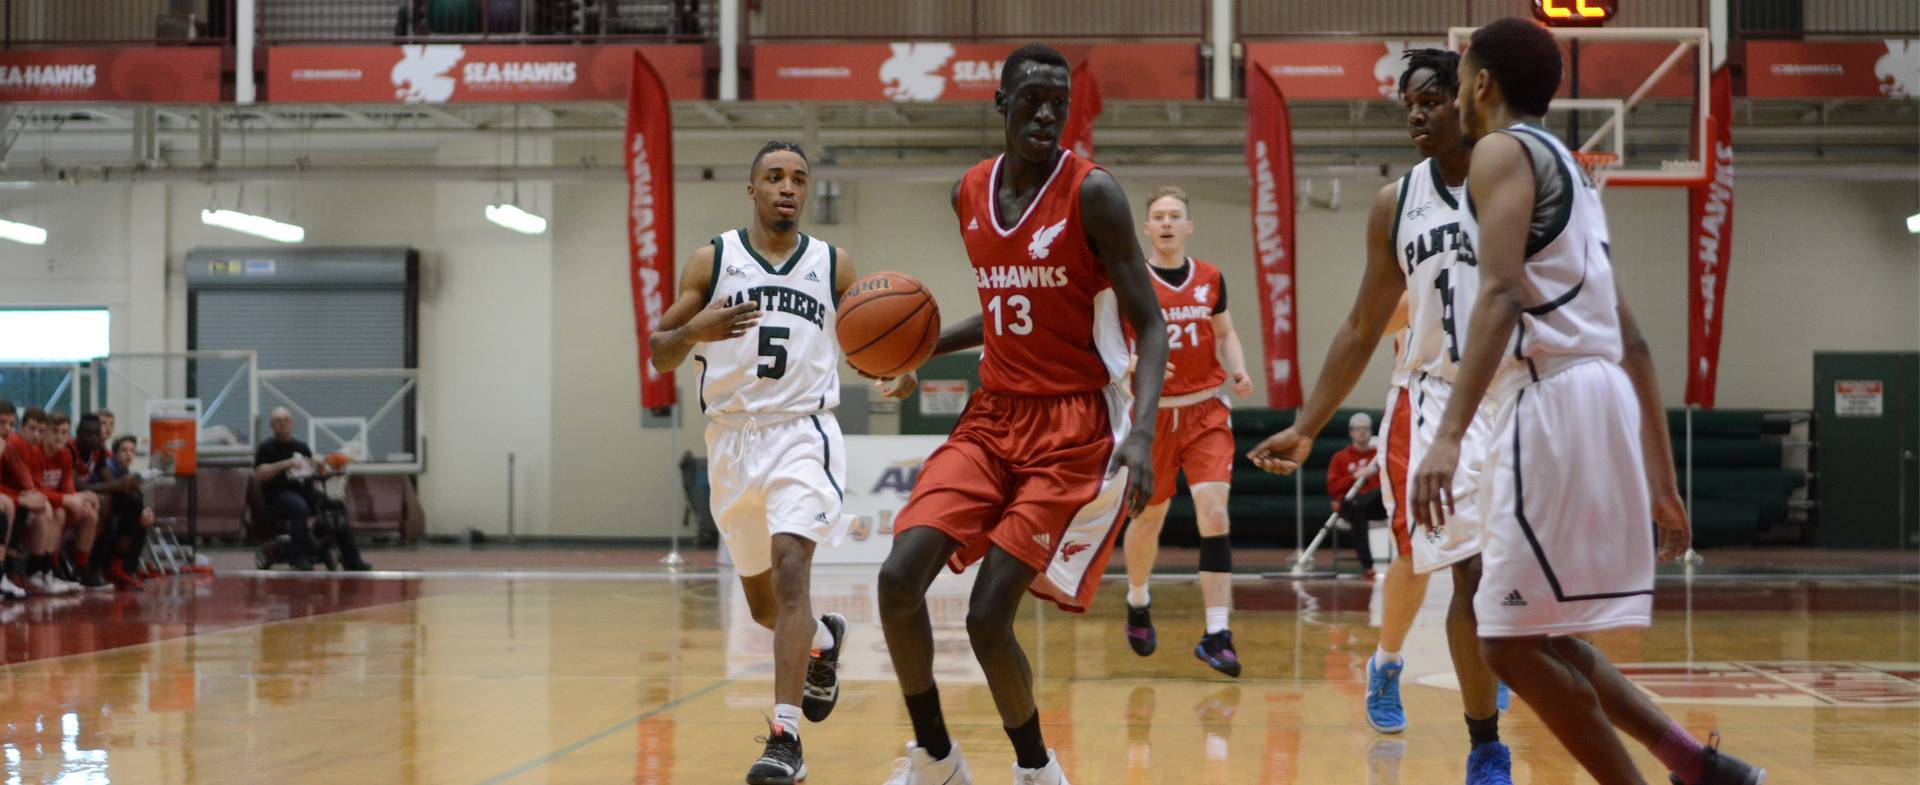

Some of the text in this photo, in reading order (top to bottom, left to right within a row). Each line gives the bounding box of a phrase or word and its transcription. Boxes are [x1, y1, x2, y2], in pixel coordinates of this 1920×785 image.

[0, 64, 97, 87] EA-HAWKS
[972, 265, 1069, 289] EA-HAWKS
[987, 294, 1034, 336] 13
[1166, 322, 1199, 349] 21
[756, 325, 791, 380] 5
